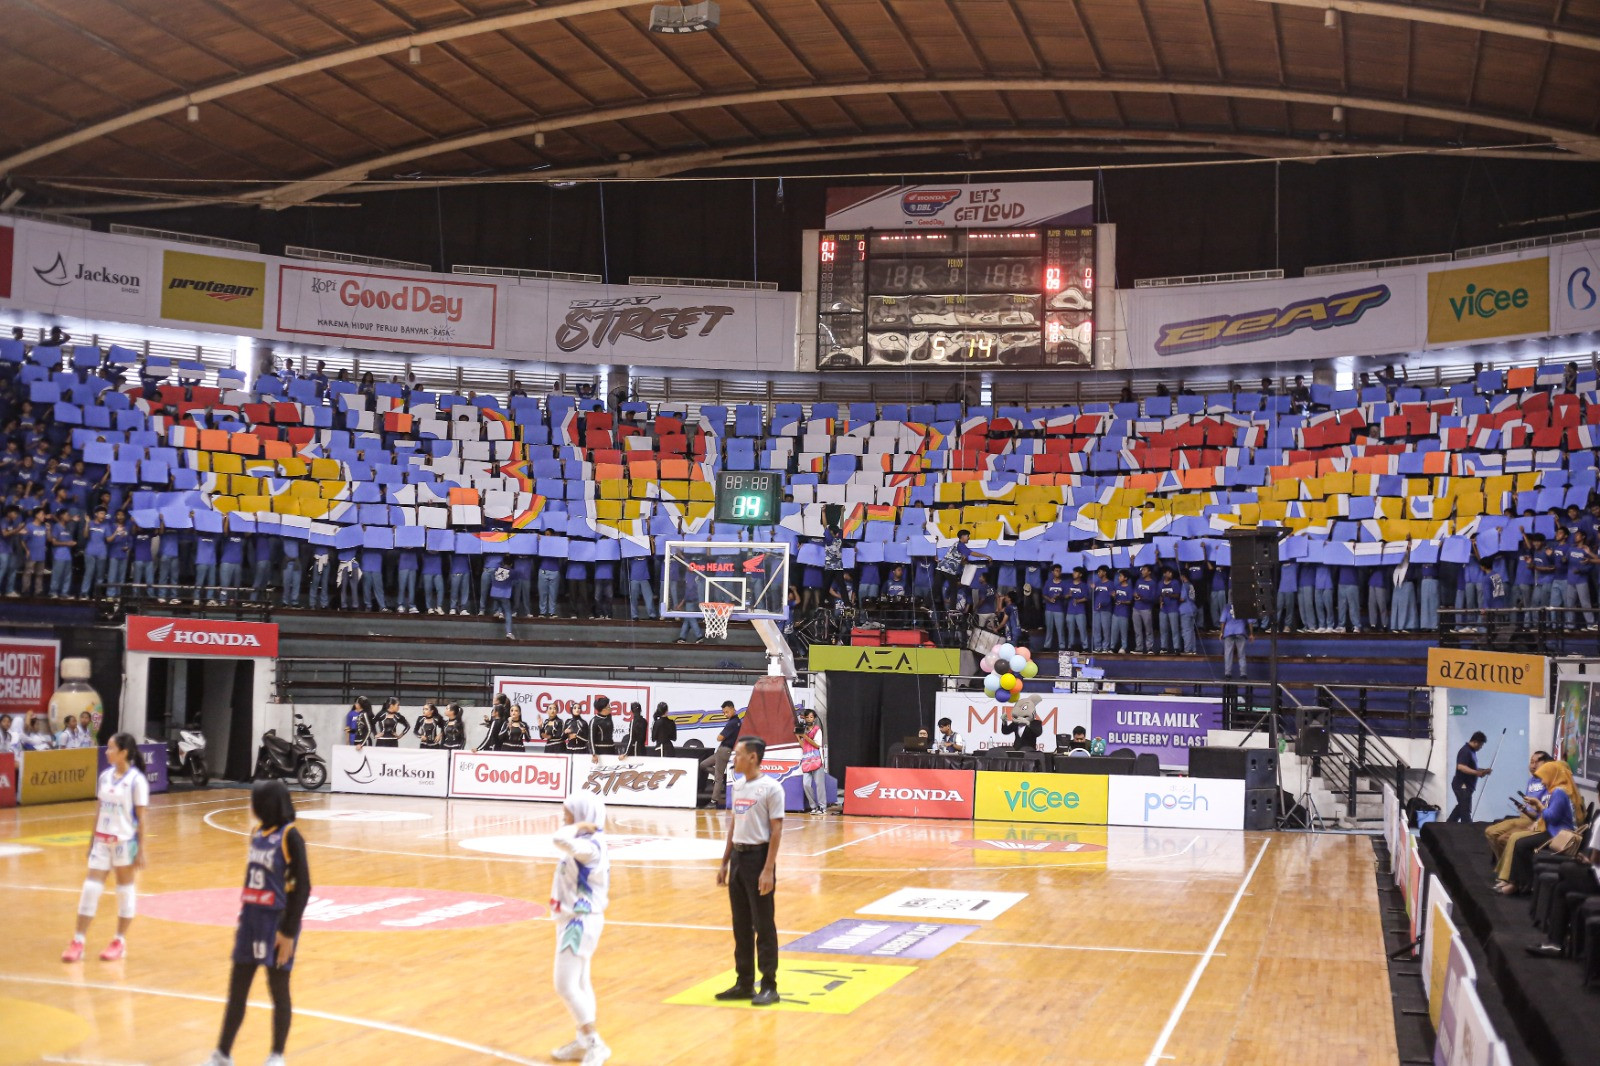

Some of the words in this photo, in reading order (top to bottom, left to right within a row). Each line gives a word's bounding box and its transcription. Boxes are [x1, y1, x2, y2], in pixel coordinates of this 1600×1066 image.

[970, 188, 1001, 204] LET'S
[954, 205, 983, 222] GET
[982, 202, 1025, 222] LOUD
[821, 241, 835, 252] 01
[858, 241, 866, 251] 0
[821, 251, 835, 262] 04
[947, 258, 964, 268] PERIOD
[75, 264, 140, 287] Jackson
[1046, 268, 1061, 279] 07
[168, 278, 255, 297] proteam
[317, 319, 349, 329] KARENA
[351, 321, 374, 331] HIDUP
[376, 323, 398, 333] PERLU
[400, 325, 429, 335] BANYAK
[433, 328, 451, 337] RASA
[554, 304, 735, 352] STREET
[932, 337, 946, 360] 5
[968, 337, 993, 358] 14
[689, 562, 706, 571] One
[173, 630, 262, 647] HONDA
[1116, 711, 1162, 727] ULTRA
[1163, 713, 1200, 729] MILK
[1108, 732, 1169, 746] BLUEBERRY
[1173, 735, 1208, 747] BLAST
[379, 763, 435, 779] Jackson
[581, 769, 688, 797] STREET
[878, 787, 964, 802] HONDA
[1144, 783, 1209, 822] posh
[248, 867, 266, 890] 19
